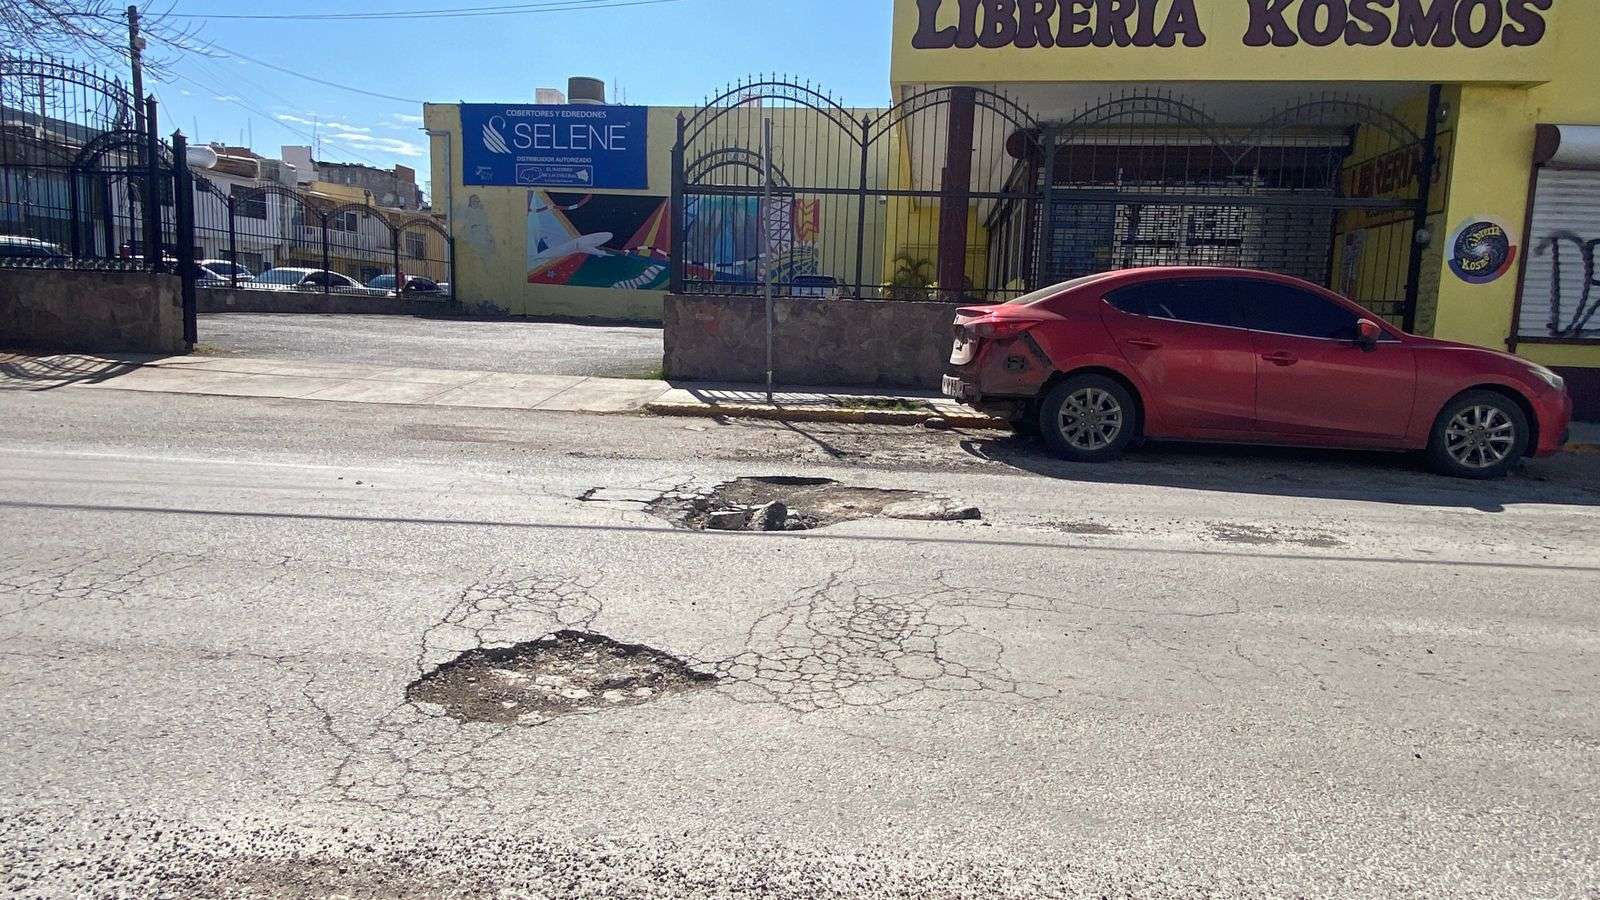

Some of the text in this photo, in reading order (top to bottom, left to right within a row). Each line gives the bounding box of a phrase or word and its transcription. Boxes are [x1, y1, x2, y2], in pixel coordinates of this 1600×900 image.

[1243, 0, 1550, 47] KOSMOS
[506, 109, 607, 119] COBERTORES Y EDREDONES
[513, 123, 626, 151] SELENE
